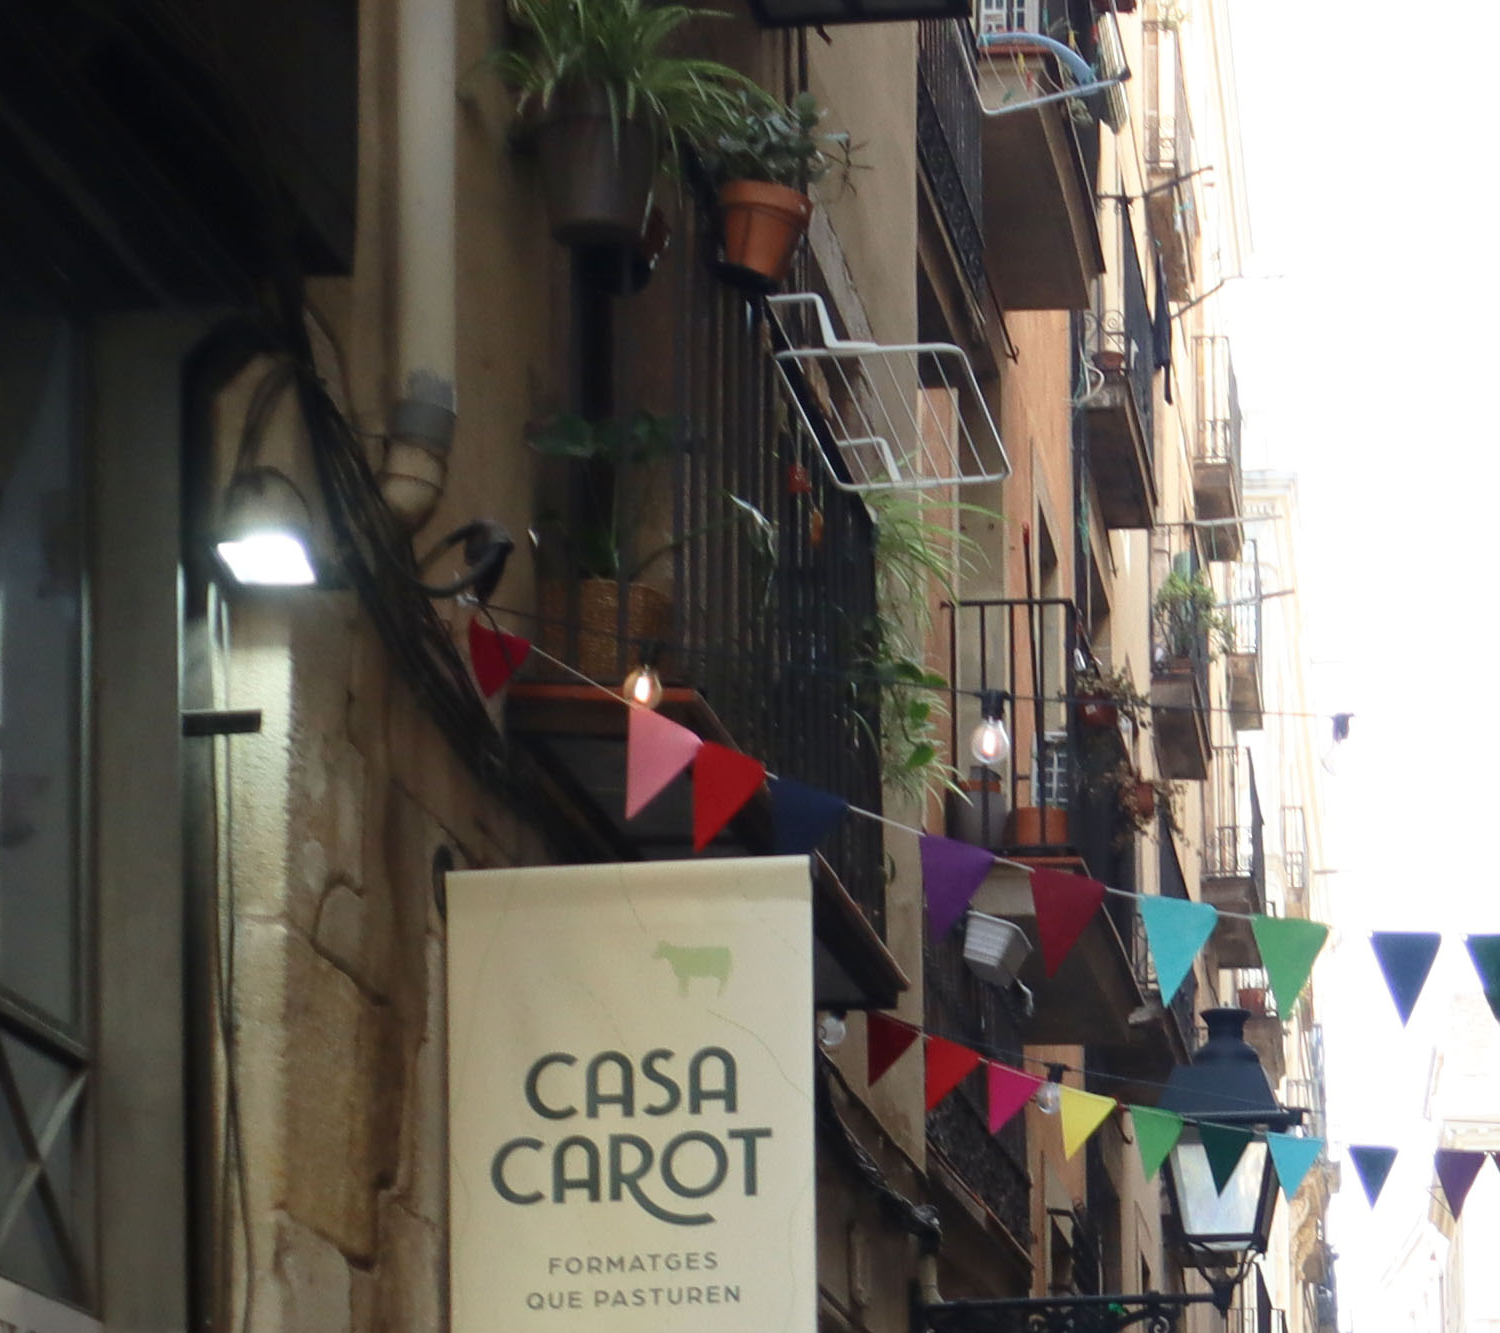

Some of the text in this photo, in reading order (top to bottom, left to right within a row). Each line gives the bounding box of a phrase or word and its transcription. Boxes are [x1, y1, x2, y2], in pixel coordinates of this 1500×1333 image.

[524, 1046, 738, 1121] CASA
[491, 1127, 773, 1227] CAROT
[548, 1251, 718, 1275] FORMATGES
[526, 1285, 741, 1311] QUE PASTUREN
